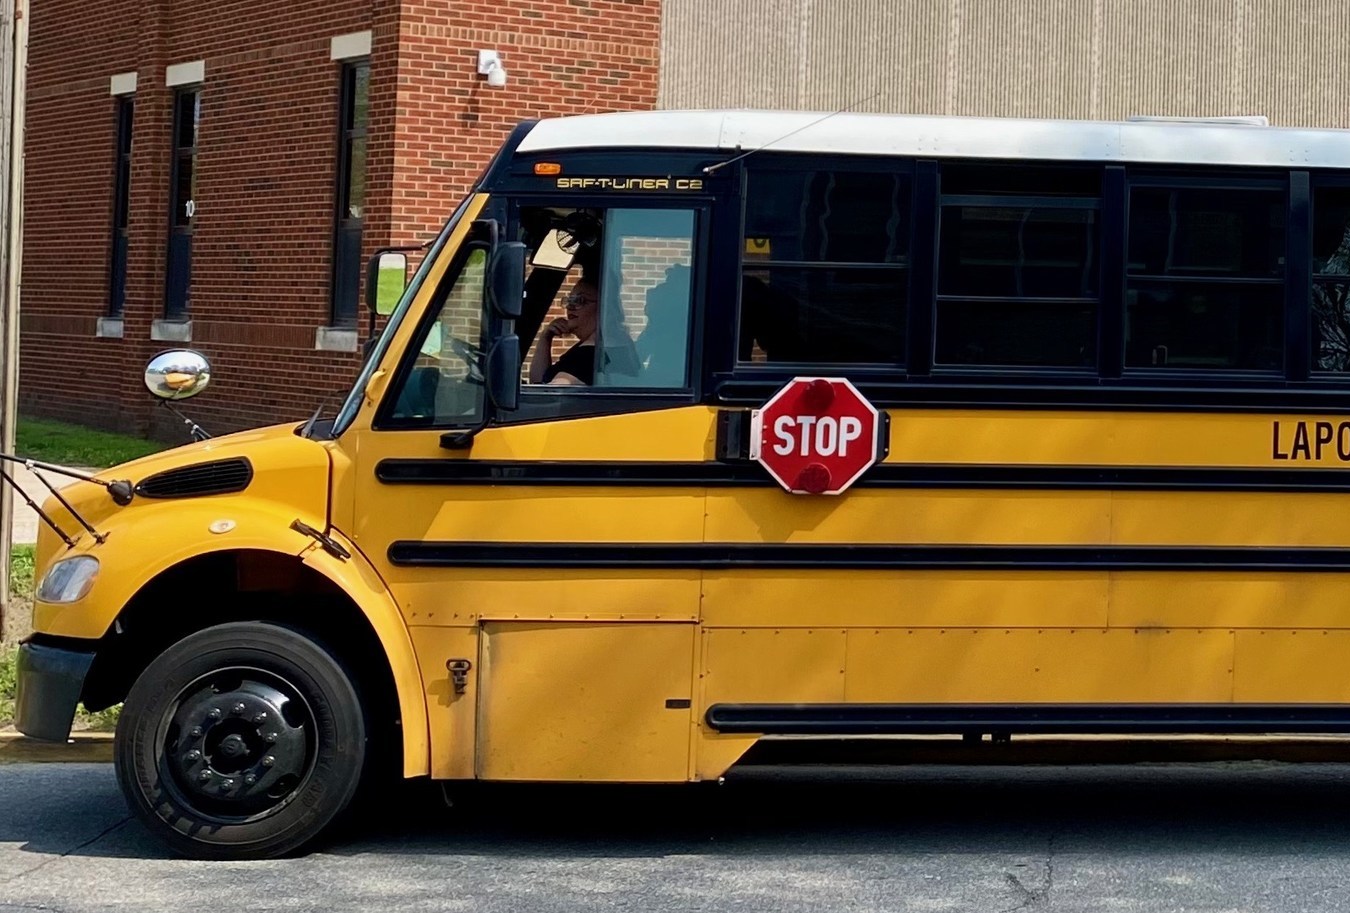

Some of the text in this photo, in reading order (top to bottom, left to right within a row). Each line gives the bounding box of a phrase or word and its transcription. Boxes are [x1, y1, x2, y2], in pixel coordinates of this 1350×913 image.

[675, 179, 703, 190] C2
[185, 199, 195, 218] 10
[773, 415, 862, 457] STOP
